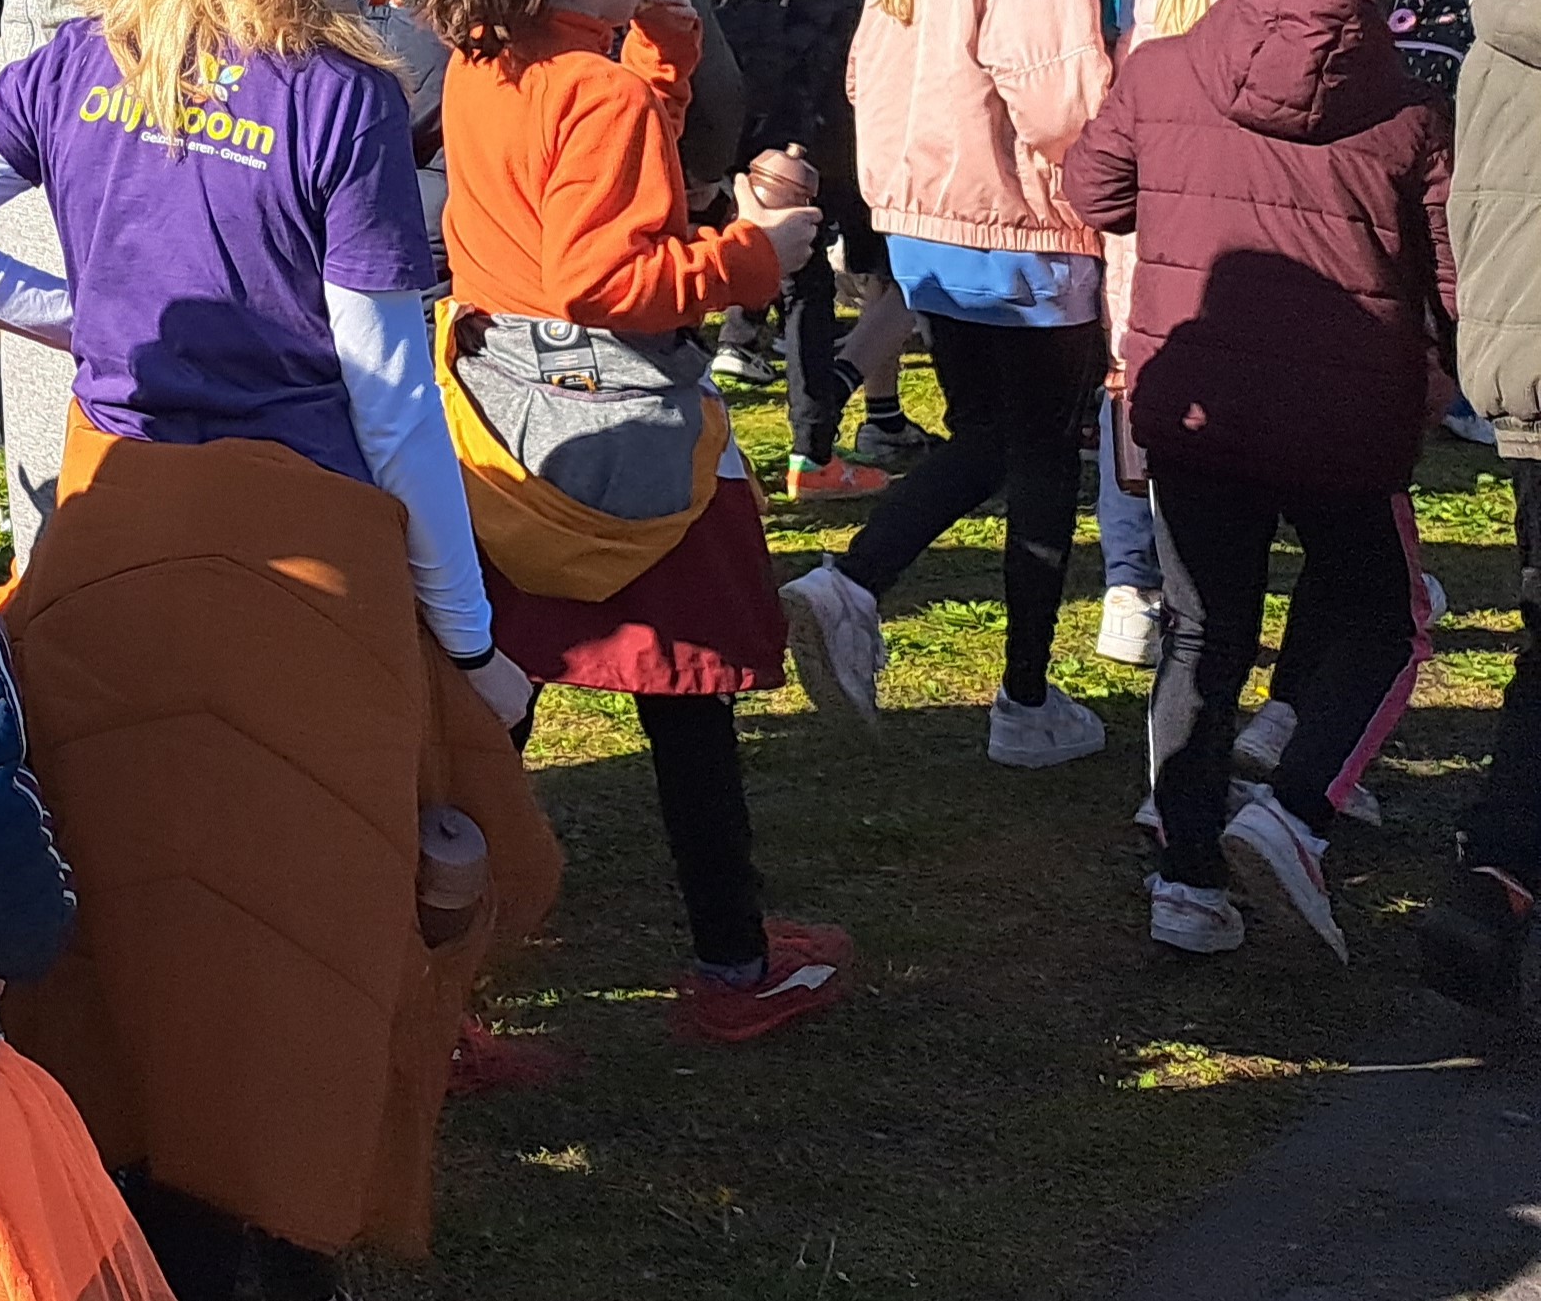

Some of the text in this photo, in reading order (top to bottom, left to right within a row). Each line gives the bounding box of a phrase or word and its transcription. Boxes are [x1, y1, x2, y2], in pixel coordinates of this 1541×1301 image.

[79, 85, 275, 155] Olijoom
[188, 140, 215, 155] eren
[220, 147, 267, 170] Groeien
